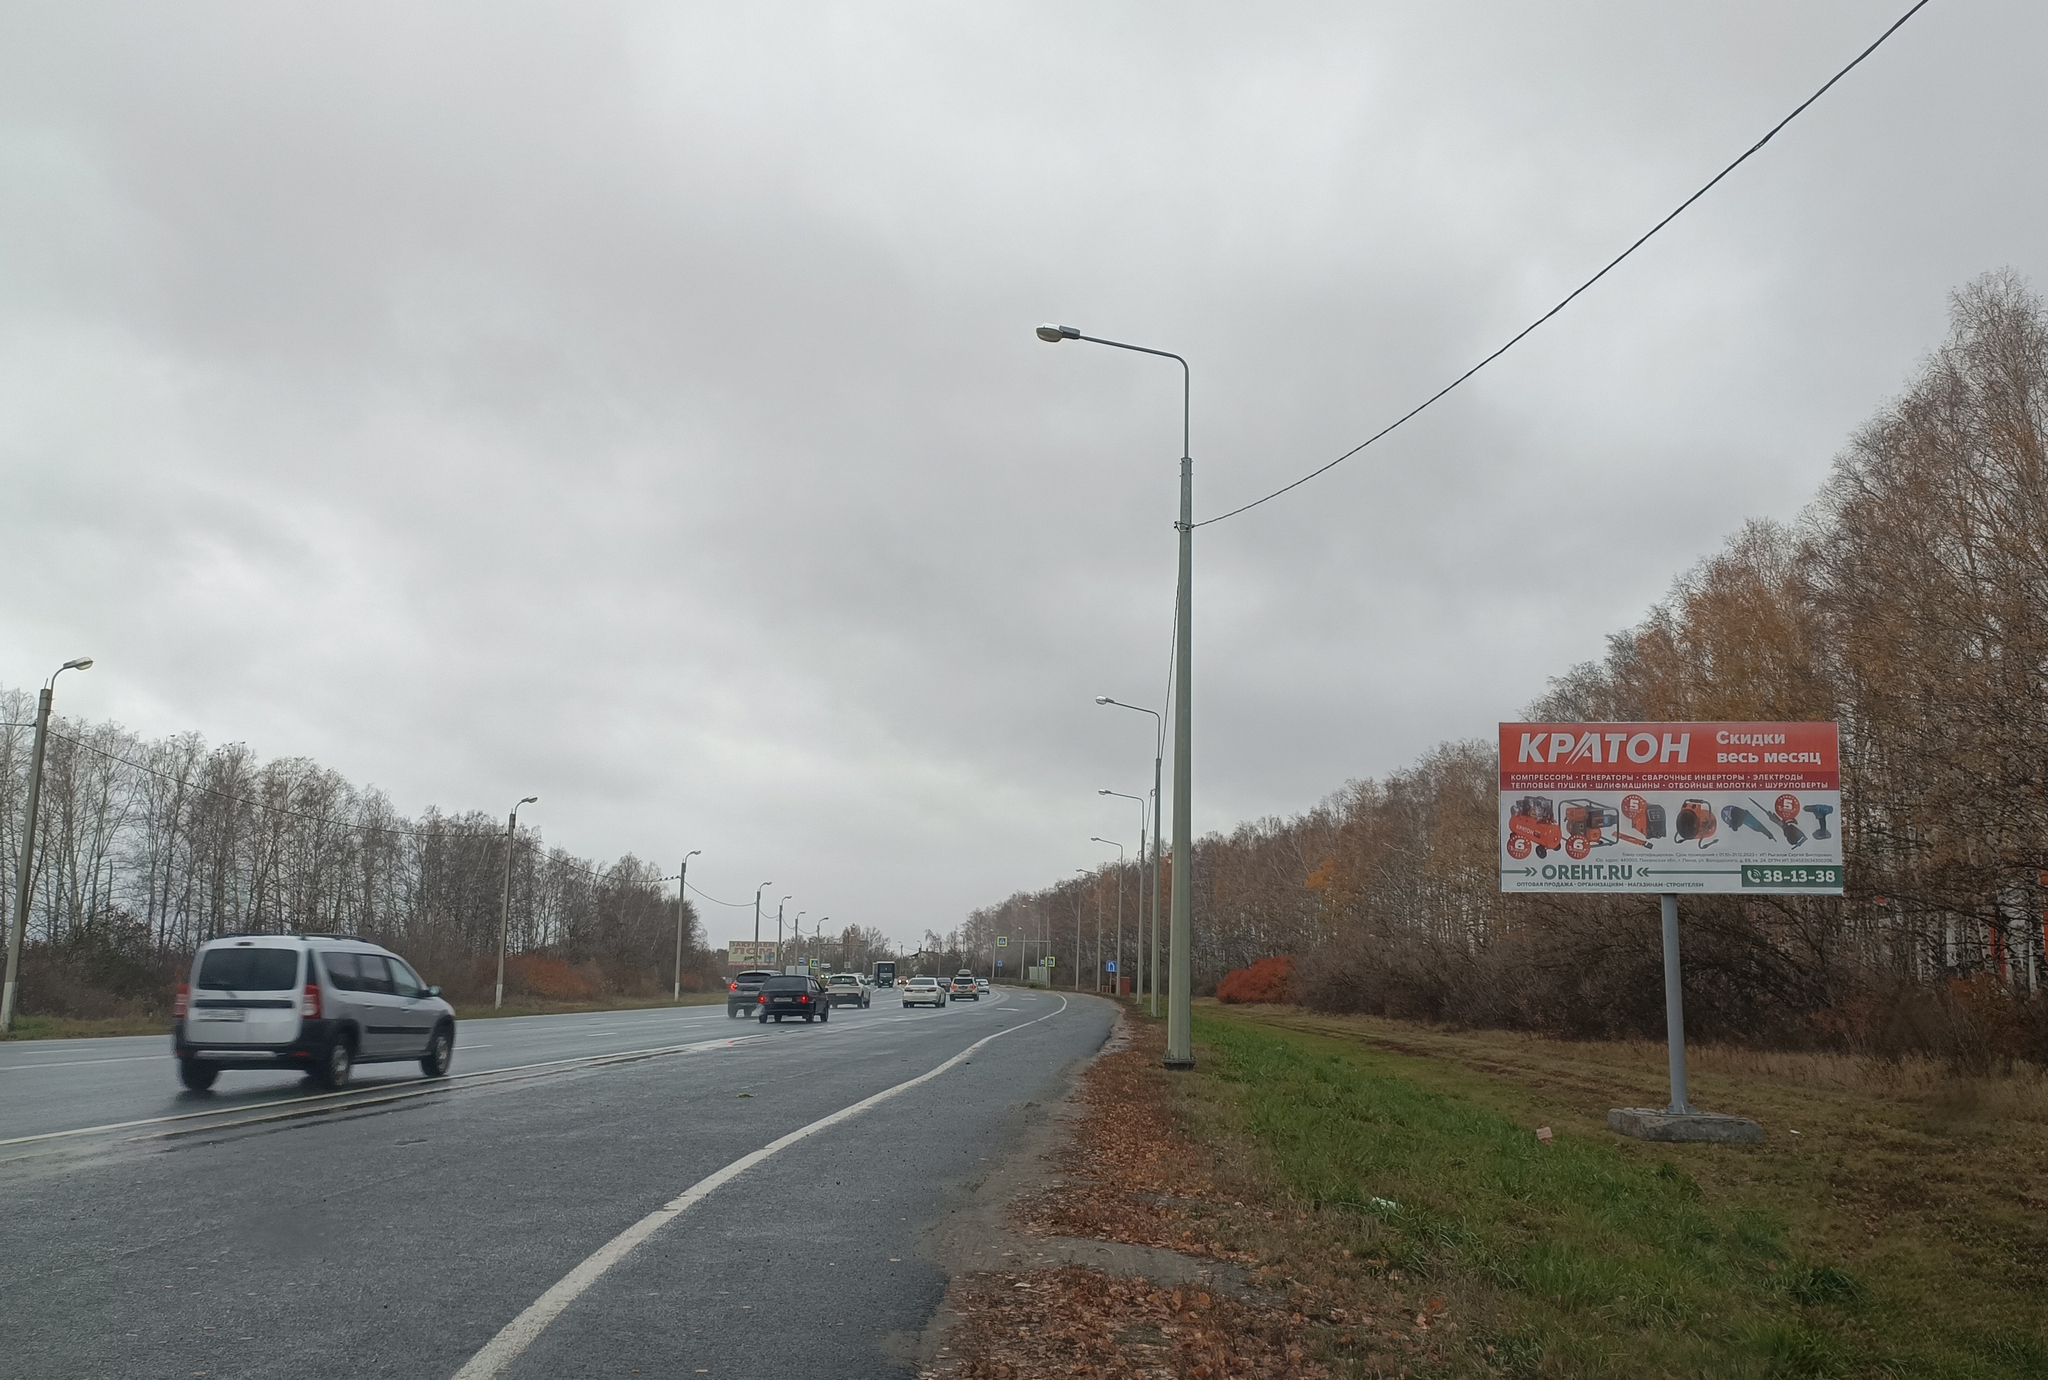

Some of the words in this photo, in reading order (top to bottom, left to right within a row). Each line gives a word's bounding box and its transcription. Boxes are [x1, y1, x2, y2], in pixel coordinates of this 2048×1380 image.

[1716, 730, 1785, 746] Скидки
[1518, 731, 1690, 764] КРАТОН
[1717, 752, 1759, 763] весь
[1764, 752, 1821, 765] месяц
[1668, 781, 1713, 789] ОТБОЙНЫЕ
[1542, 864, 1633, 880] OREHT.RU
[1763, 870, 1836, 882] 38-13-38
